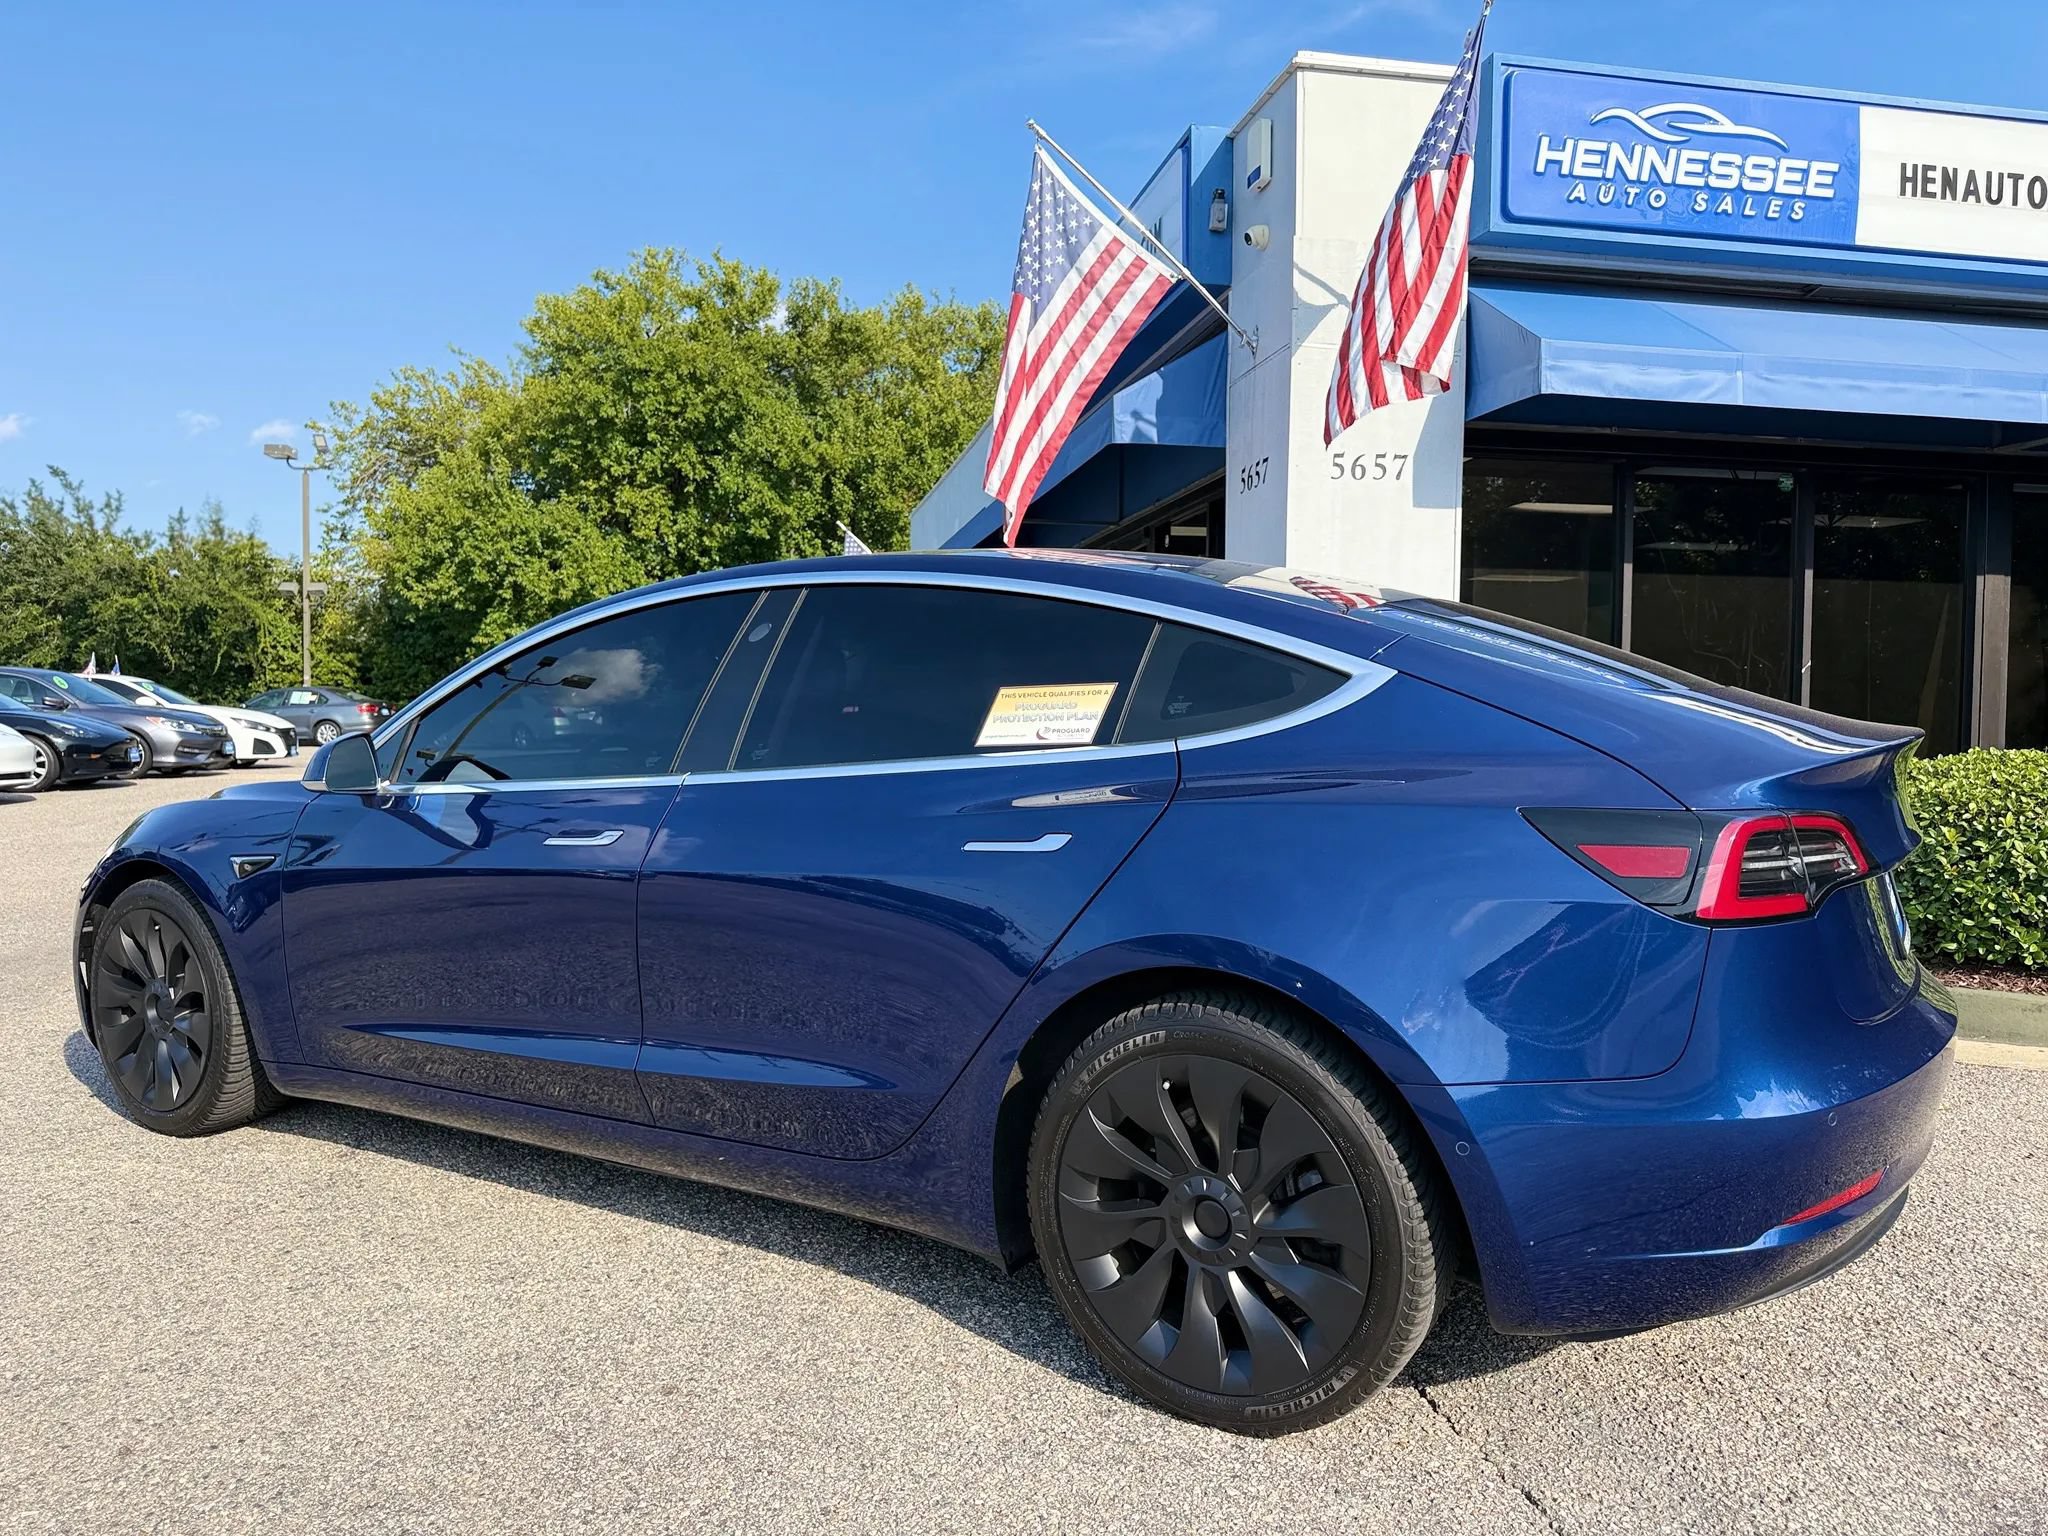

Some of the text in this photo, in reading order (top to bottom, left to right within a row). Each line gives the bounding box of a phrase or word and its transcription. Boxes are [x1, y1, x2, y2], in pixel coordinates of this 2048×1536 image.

[1535, 134, 1840, 198] HENNESSEE
[1569, 182, 1807, 220] AUTO SALES
[1240, 456, 1269, 495] 5657
[1331, 452, 1409, 481] 5657
[1018, 691, 1047, 699] VEHICLE
[993, 711, 1099, 723] PROTECTION PLAN
[1086, 1032, 1161, 1077] MICHELIN
[1250, 1381, 1336, 1418] MICHELIN
